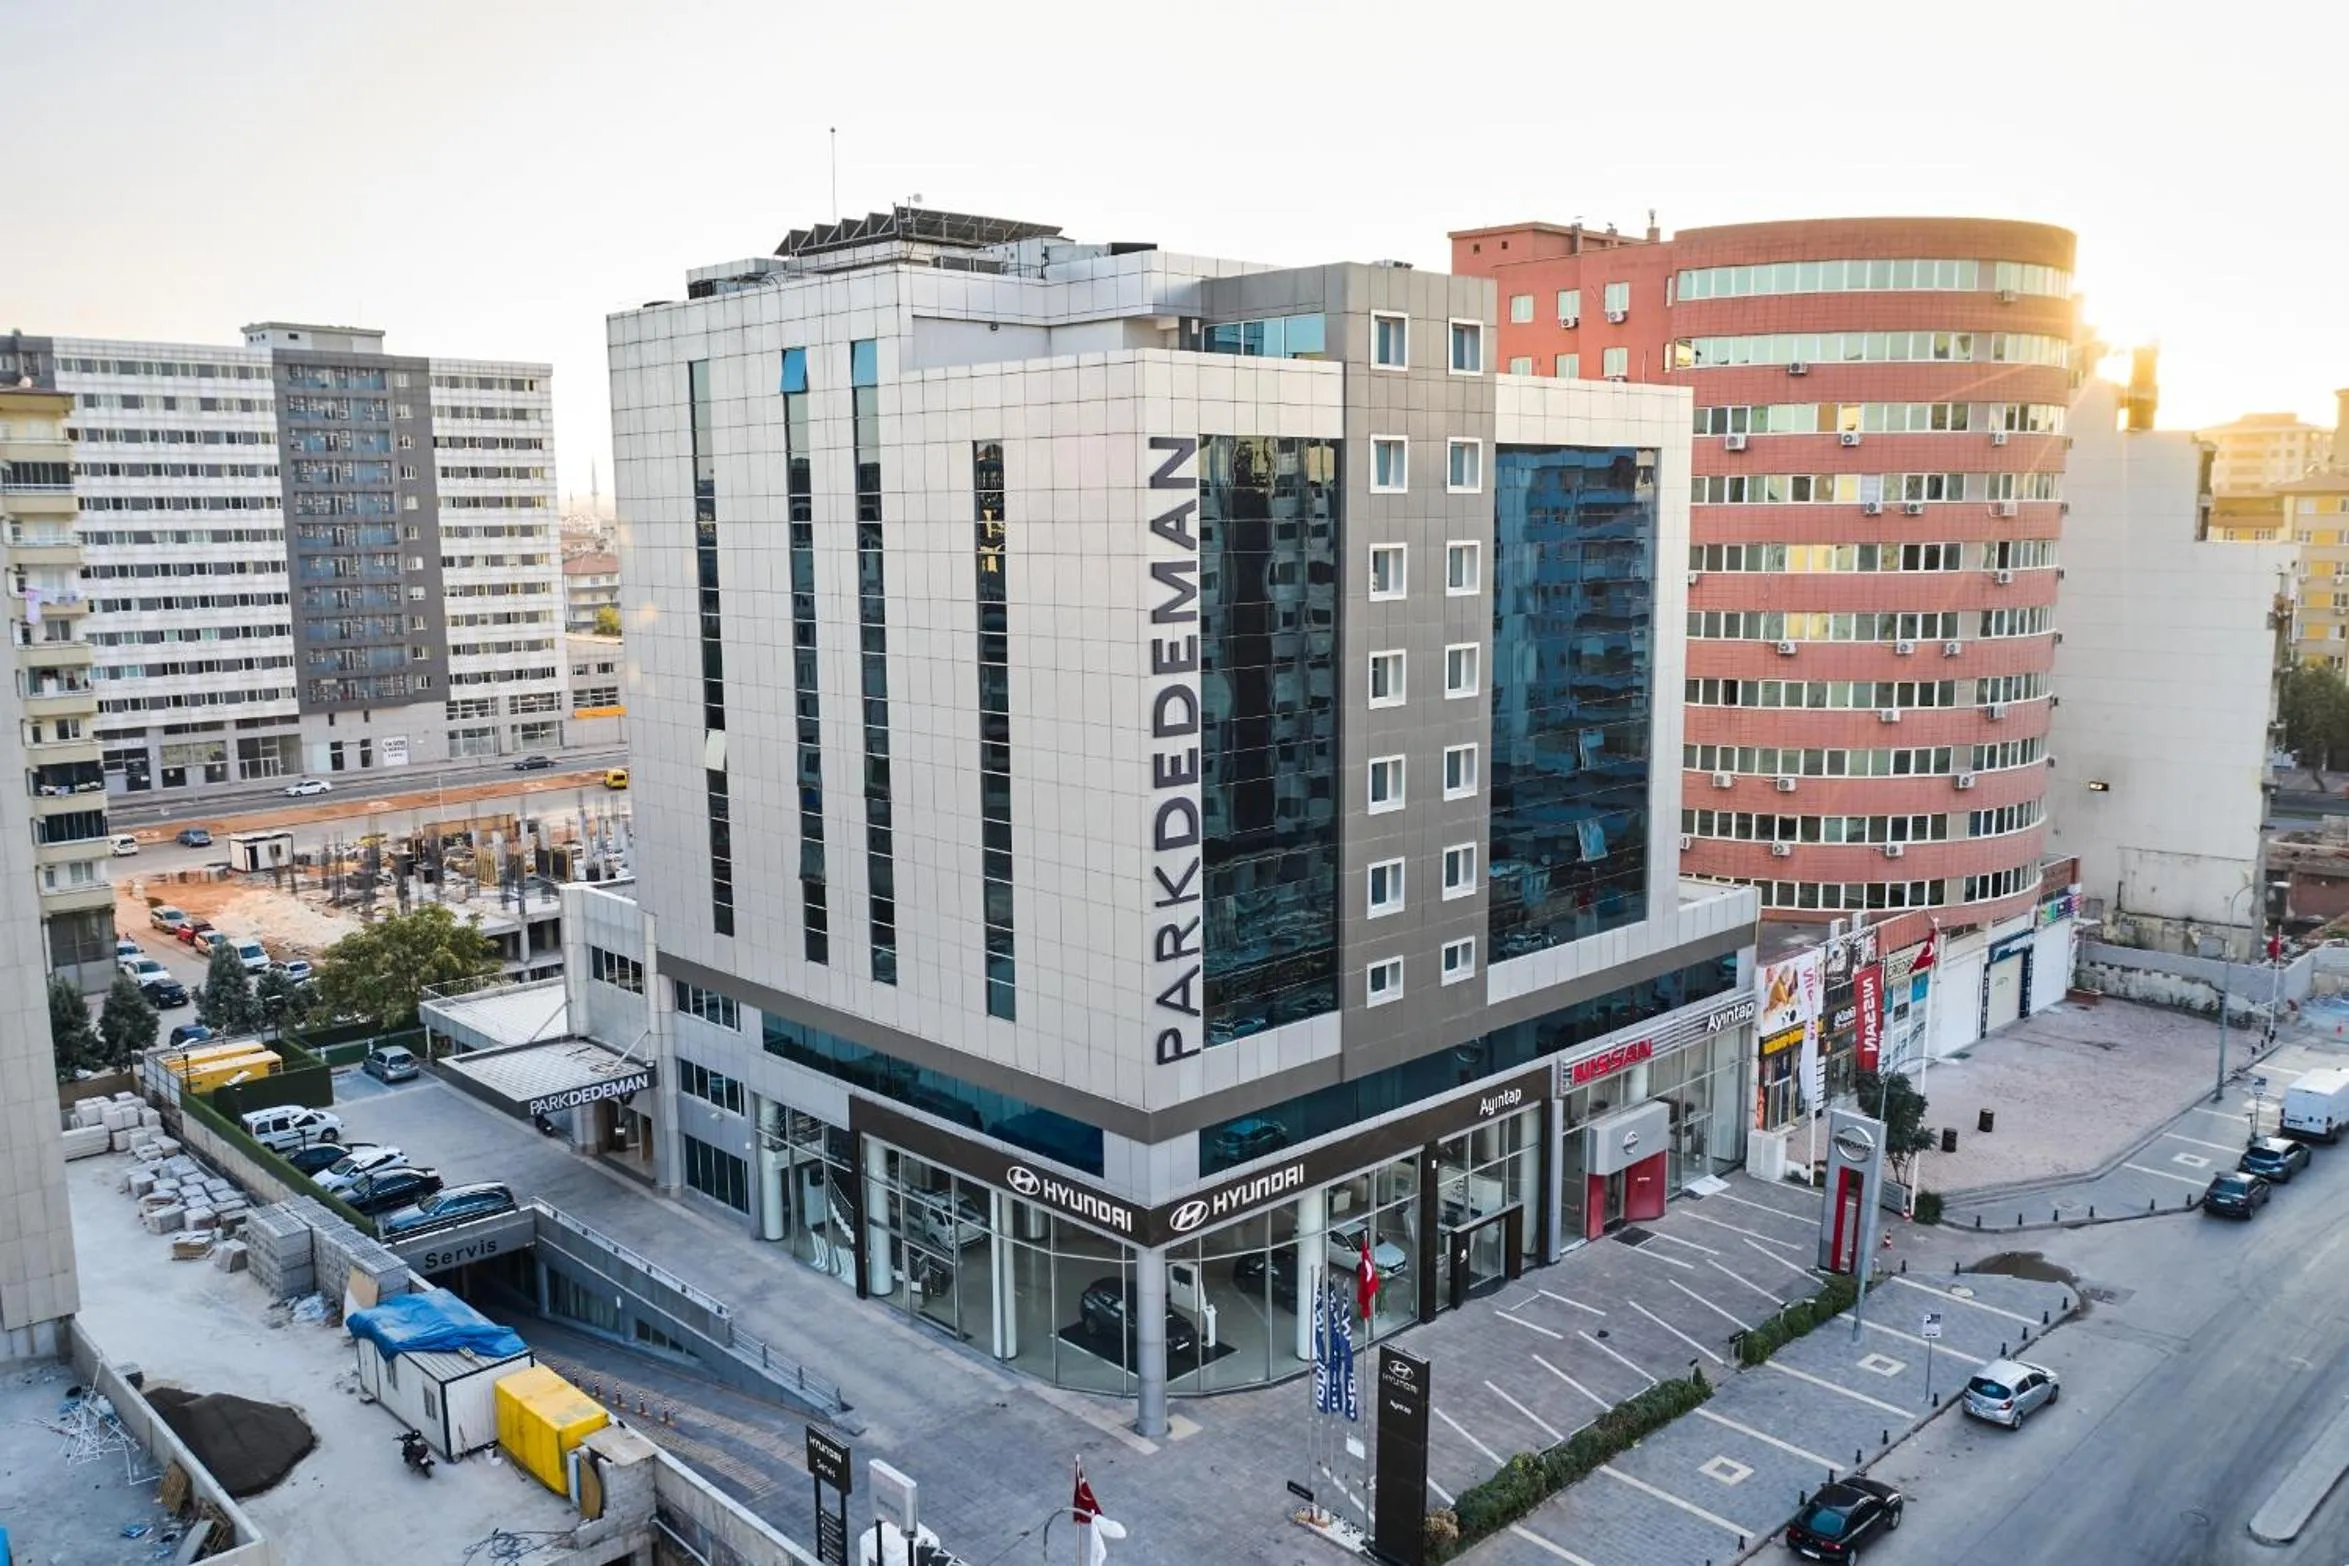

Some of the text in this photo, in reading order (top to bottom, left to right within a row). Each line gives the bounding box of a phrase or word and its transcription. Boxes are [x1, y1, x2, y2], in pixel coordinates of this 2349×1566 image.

[1571, 1038, 1654, 1085] NISSAN
[1043, 1178, 1132, 1232] HYUNDAI
[1213, 1164, 1304, 1215] HYUNDAI
[425, 1240, 497, 1269] Servis
